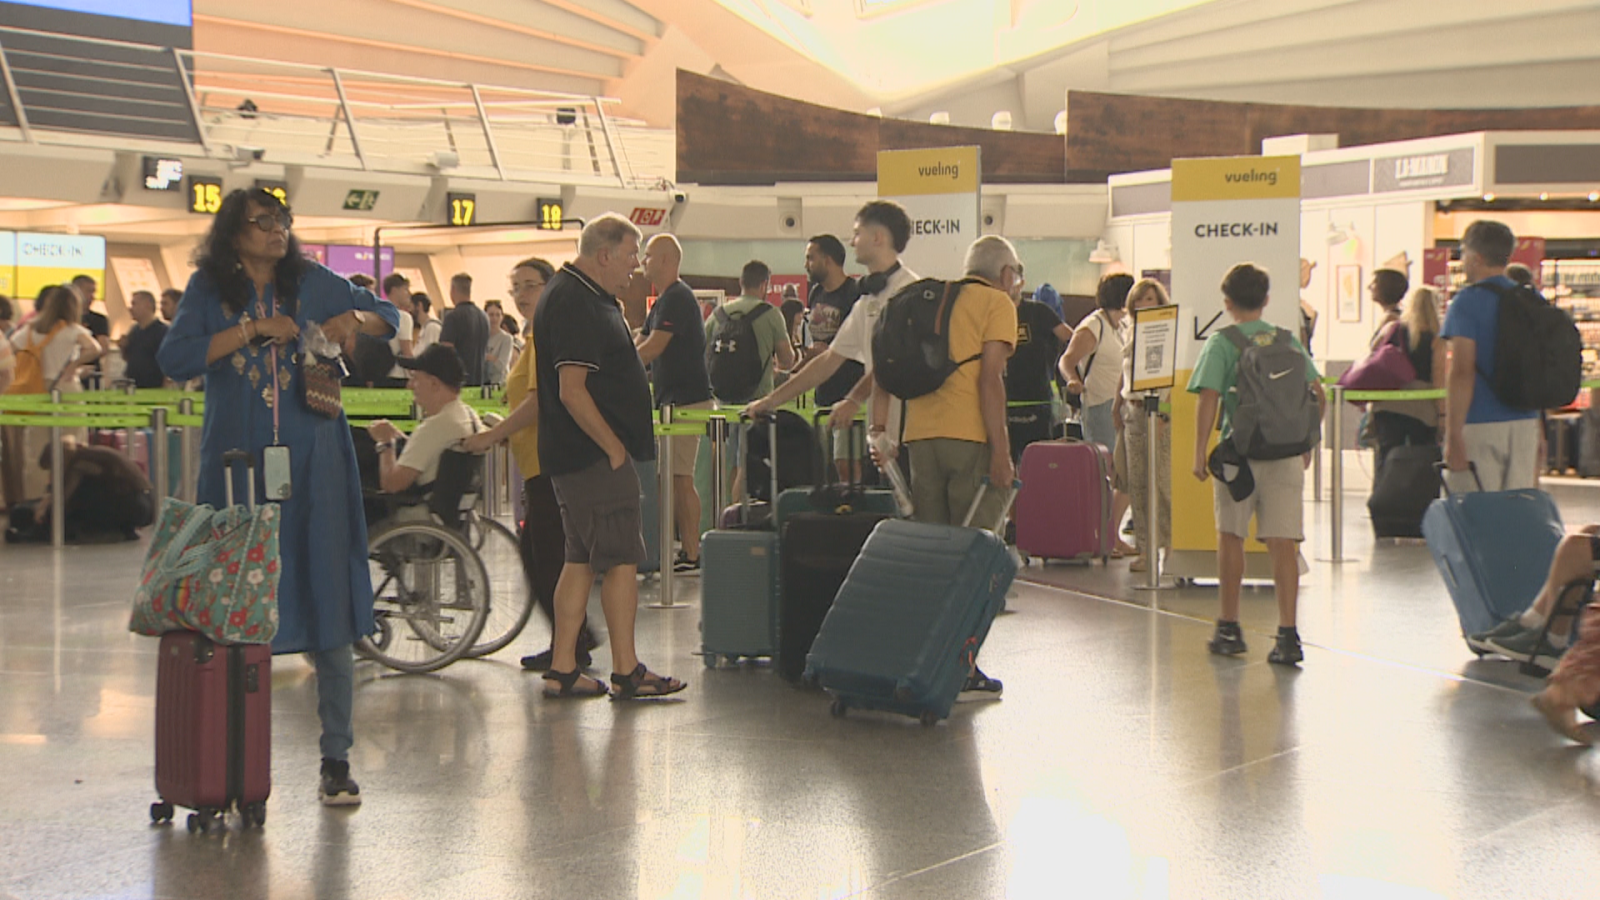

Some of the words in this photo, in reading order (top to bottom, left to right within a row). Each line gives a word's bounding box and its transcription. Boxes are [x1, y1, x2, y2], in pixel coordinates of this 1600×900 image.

[918, 161, 959, 180] vueling
[1225, 168, 1277, 186] vueling
[193, 183, 222, 213] 15
[452, 199, 474, 226] 17
[911, 219, 960, 235] ECK-IN
[1194, 222, 1278, 238] CHECK-IN
